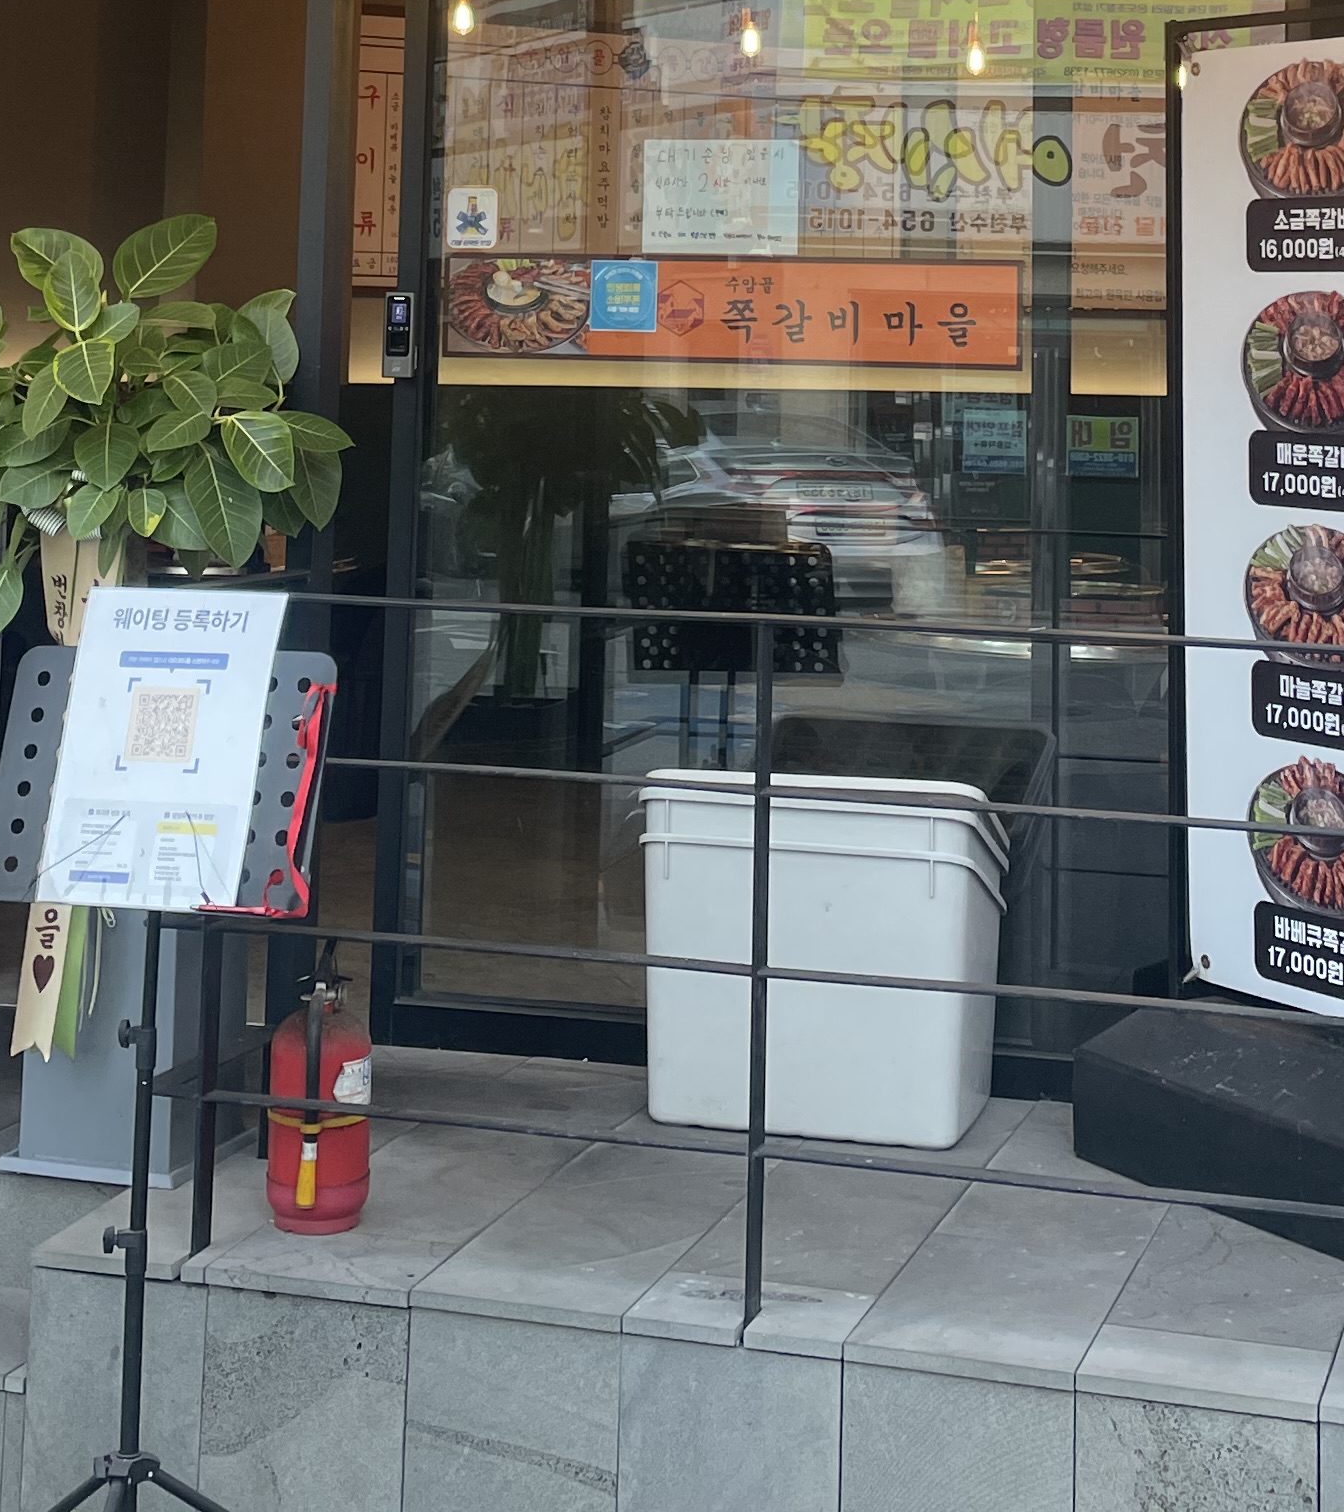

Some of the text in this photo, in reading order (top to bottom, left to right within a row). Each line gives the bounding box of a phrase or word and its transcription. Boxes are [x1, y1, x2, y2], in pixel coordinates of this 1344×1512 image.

[725, 276, 775, 294] 수암골
[113, 607, 250, 634] 웨이팅 등록하기
